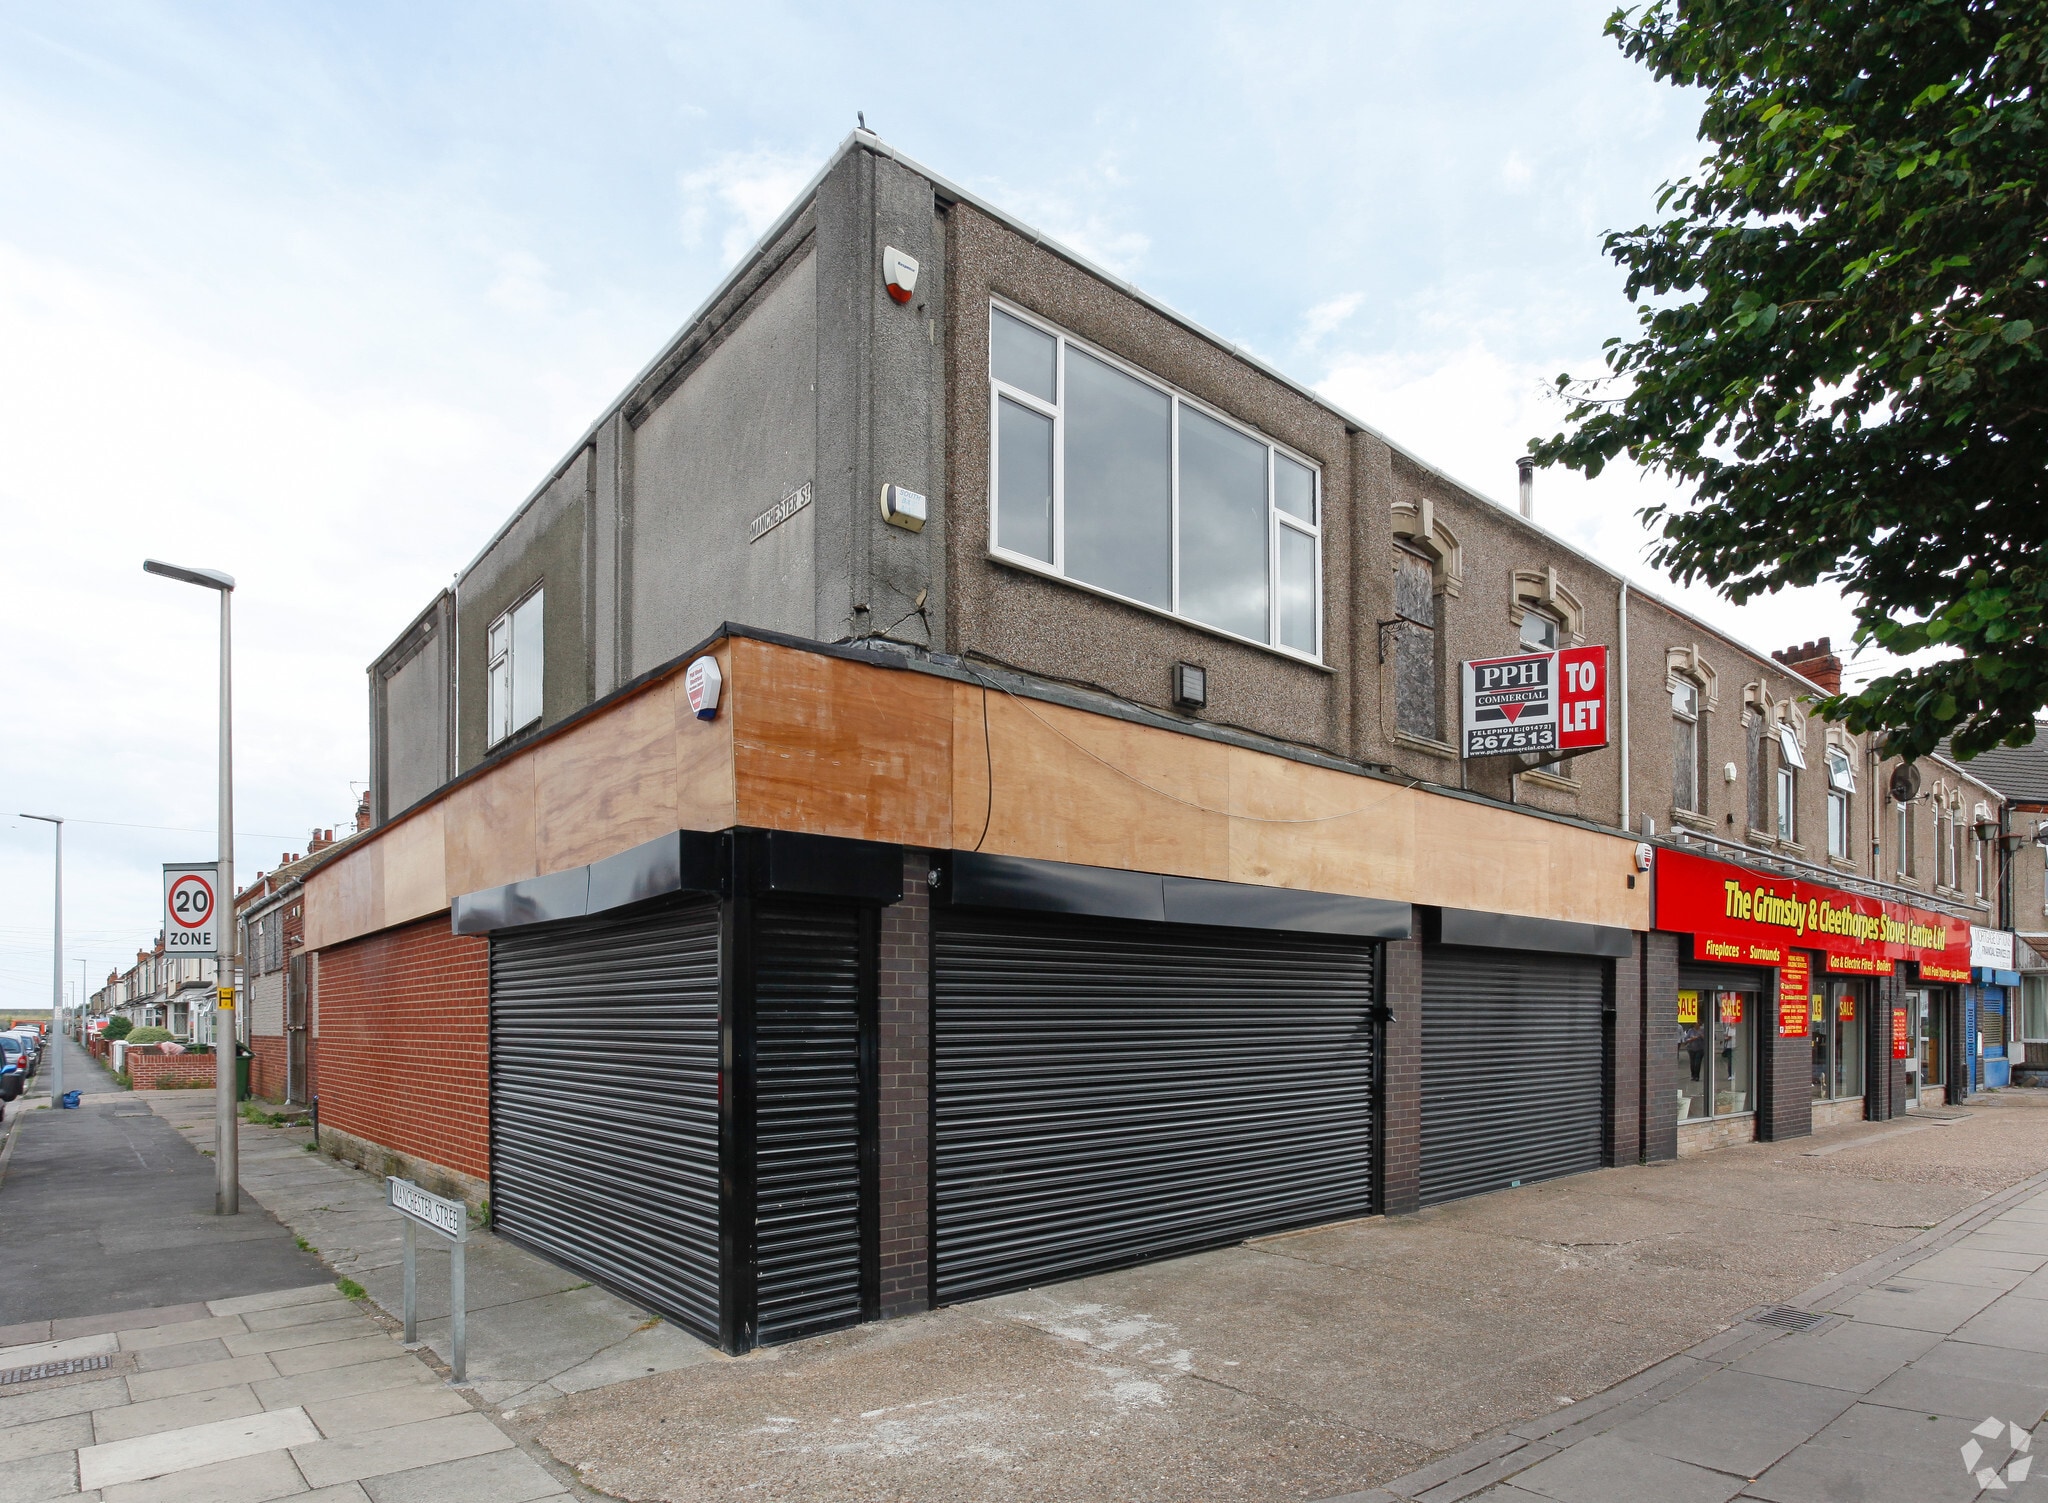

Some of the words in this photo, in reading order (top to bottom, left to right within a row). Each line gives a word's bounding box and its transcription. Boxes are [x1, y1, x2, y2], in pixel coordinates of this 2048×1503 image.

[751, 493, 798, 538] MANCHESTER
[1482, 662, 1540, 689] PPH
[1566, 661, 1596, 693] TO
[1478, 691, 1546, 705] COMMERCIAL
[1562, 700, 1600, 732] LET
[1469, 744, 1554, 757] www.pph-commercial.co.uk
[1471, 730, 1553, 750] 267513
[176, 890, 208, 912] 20
[1724, 880, 1752, 920] The
[1753, 886, 1807, 937] Grimsby
[1808, 897, 1818, 931] &
[1819, 900, 1879, 945] Cleethorpes
[1880, 912, 1906, 945] Stove
[1933, 924, 1946, 951] Ltd
[170, 932, 211, 945] ZONE
[1705, 940, 1740, 959] Fireplaces
[1749, 945, 1780, 962] Surrounds
[1830, 955, 1839, 968] Gas
[1840, 956, 1844, 968] &
[1844, 956, 1861, 970] Electric
[1861, 958, 1873, 971] Fires
[1876, 959, 1892, 971] Boilers
[1722, 999, 1741, 1017] SALE
[1812, 1001, 1821, 1015] LE
[1840, 1001, 1853, 1016] SALE
[393, 1183, 433, 1220] MANCHESTER
[435, 1203, 457, 1231] STREE
